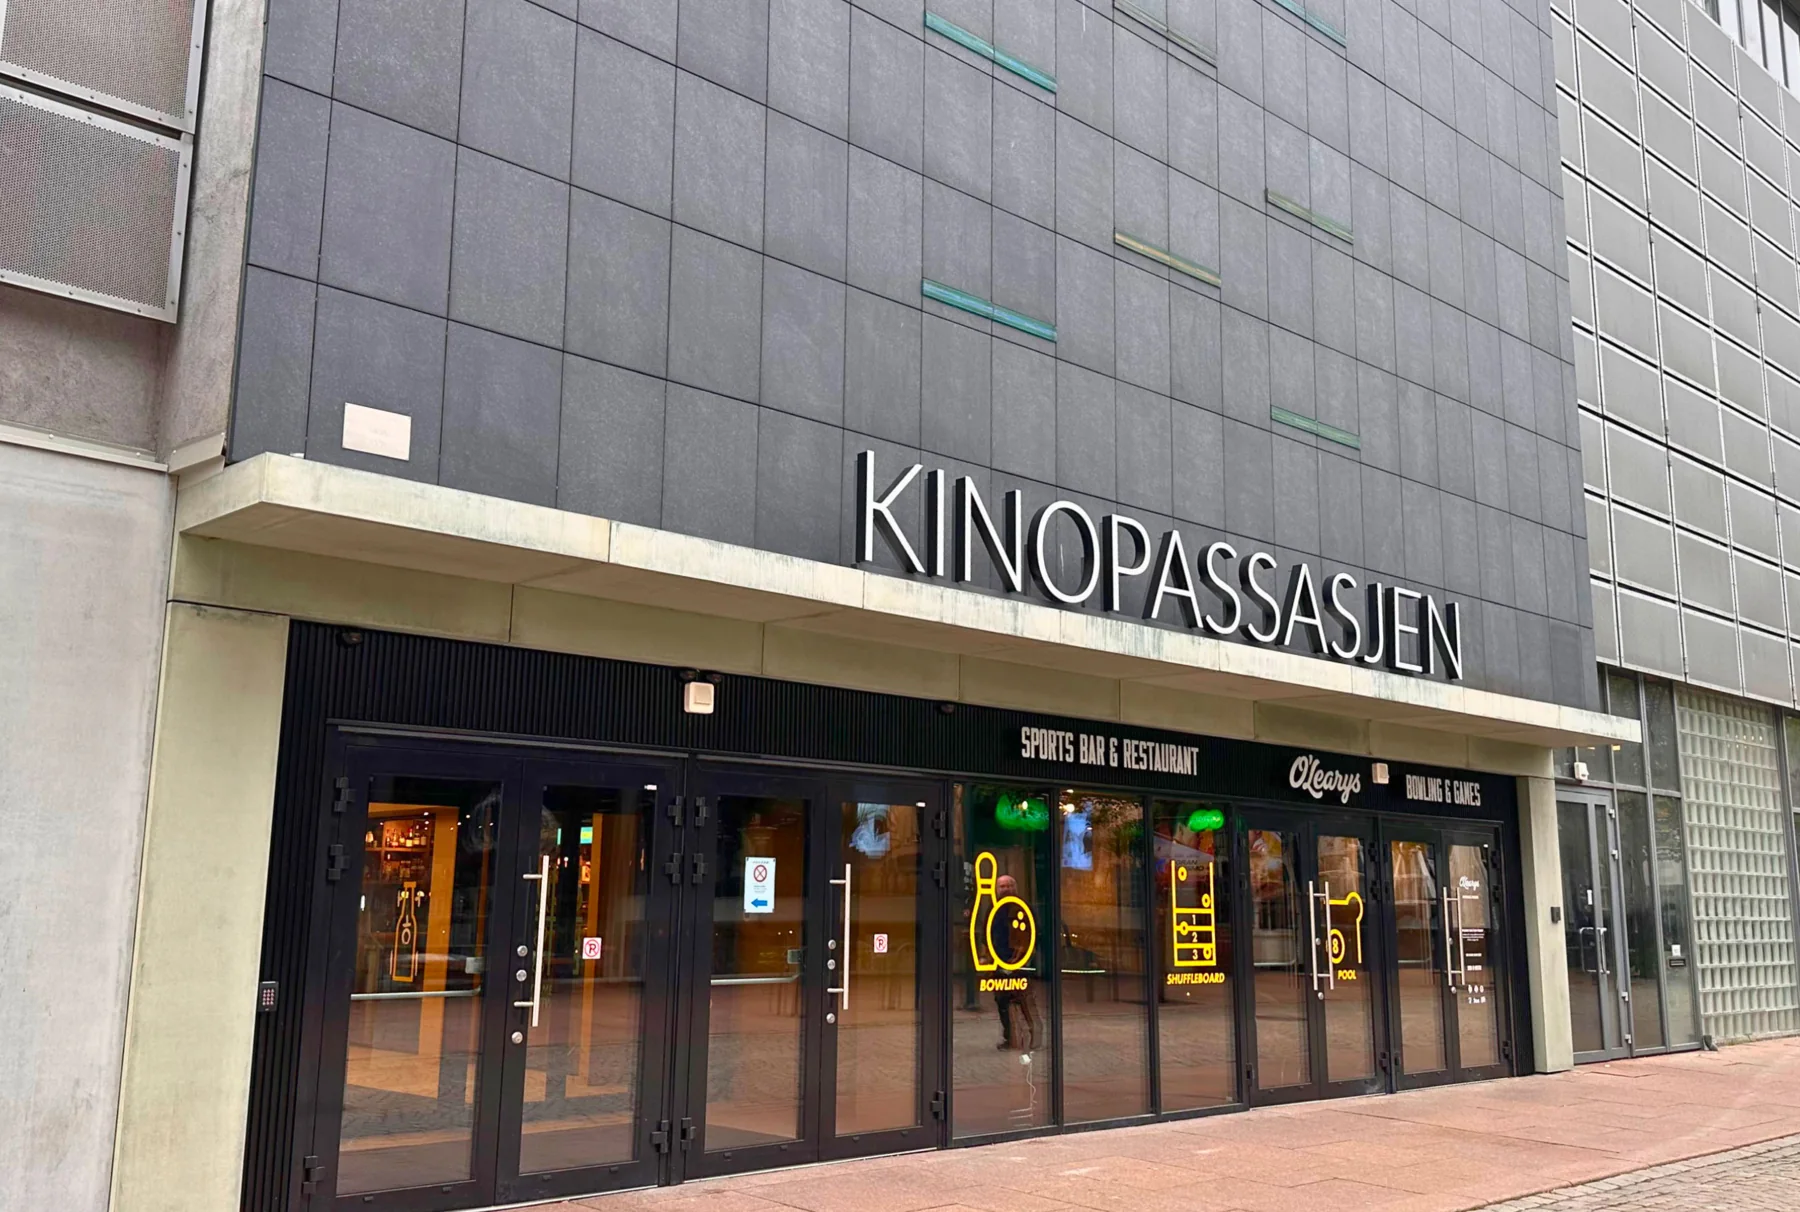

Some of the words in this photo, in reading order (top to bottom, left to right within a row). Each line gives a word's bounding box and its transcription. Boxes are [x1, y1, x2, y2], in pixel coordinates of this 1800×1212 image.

[858, 449, 1464, 681] KINOPASSASJEN
[1021, 726, 1074, 763] SPORTS
[1079, 733, 1105, 766] BAR
[1109, 737, 1118, 767] &
[1123, 738, 1199, 776] RESTAURANT
[1289, 754, 1361, 804] O'Learys
[1406, 774, 1443, 803] BOWLING
[1445, 780, 1452, 803] &
[1453, 780, 1481, 806] GAMES
[1191, 914, 1197, 926] 1
[1192, 932, 1198, 942] 2
[1332, 938, 1339, 954] 8
[1192, 949, 1198, 960] 3
[1166, 972, 1225, 985] SHUFFLEBOARD
[1337, 969, 1357, 980] POOL
[980, 977, 1028, 992] BOWLING
